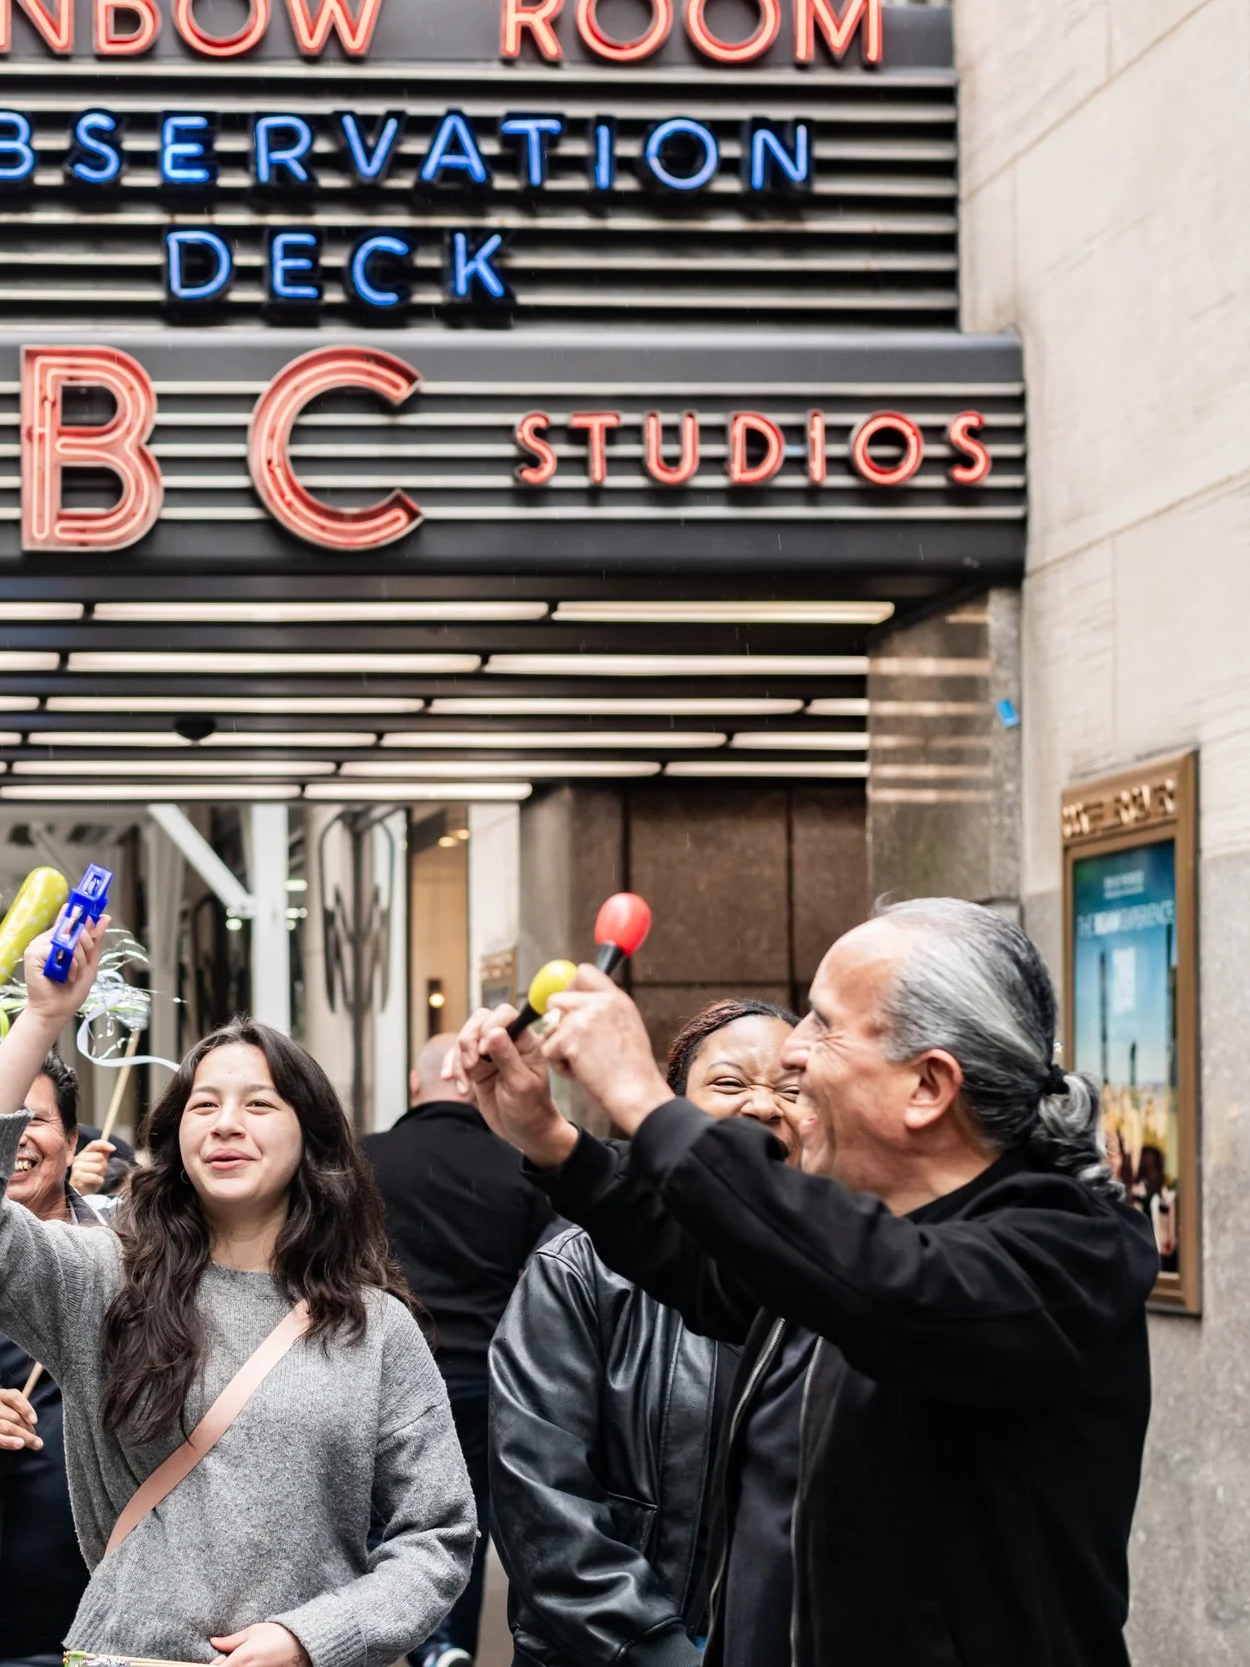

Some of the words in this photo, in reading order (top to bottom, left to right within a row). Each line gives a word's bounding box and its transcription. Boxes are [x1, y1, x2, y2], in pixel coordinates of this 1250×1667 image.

[500, 0, 883, 65] ROOM
[165, 228, 507, 309] DECK
[515, 410, 993, 486] STUDIOS
